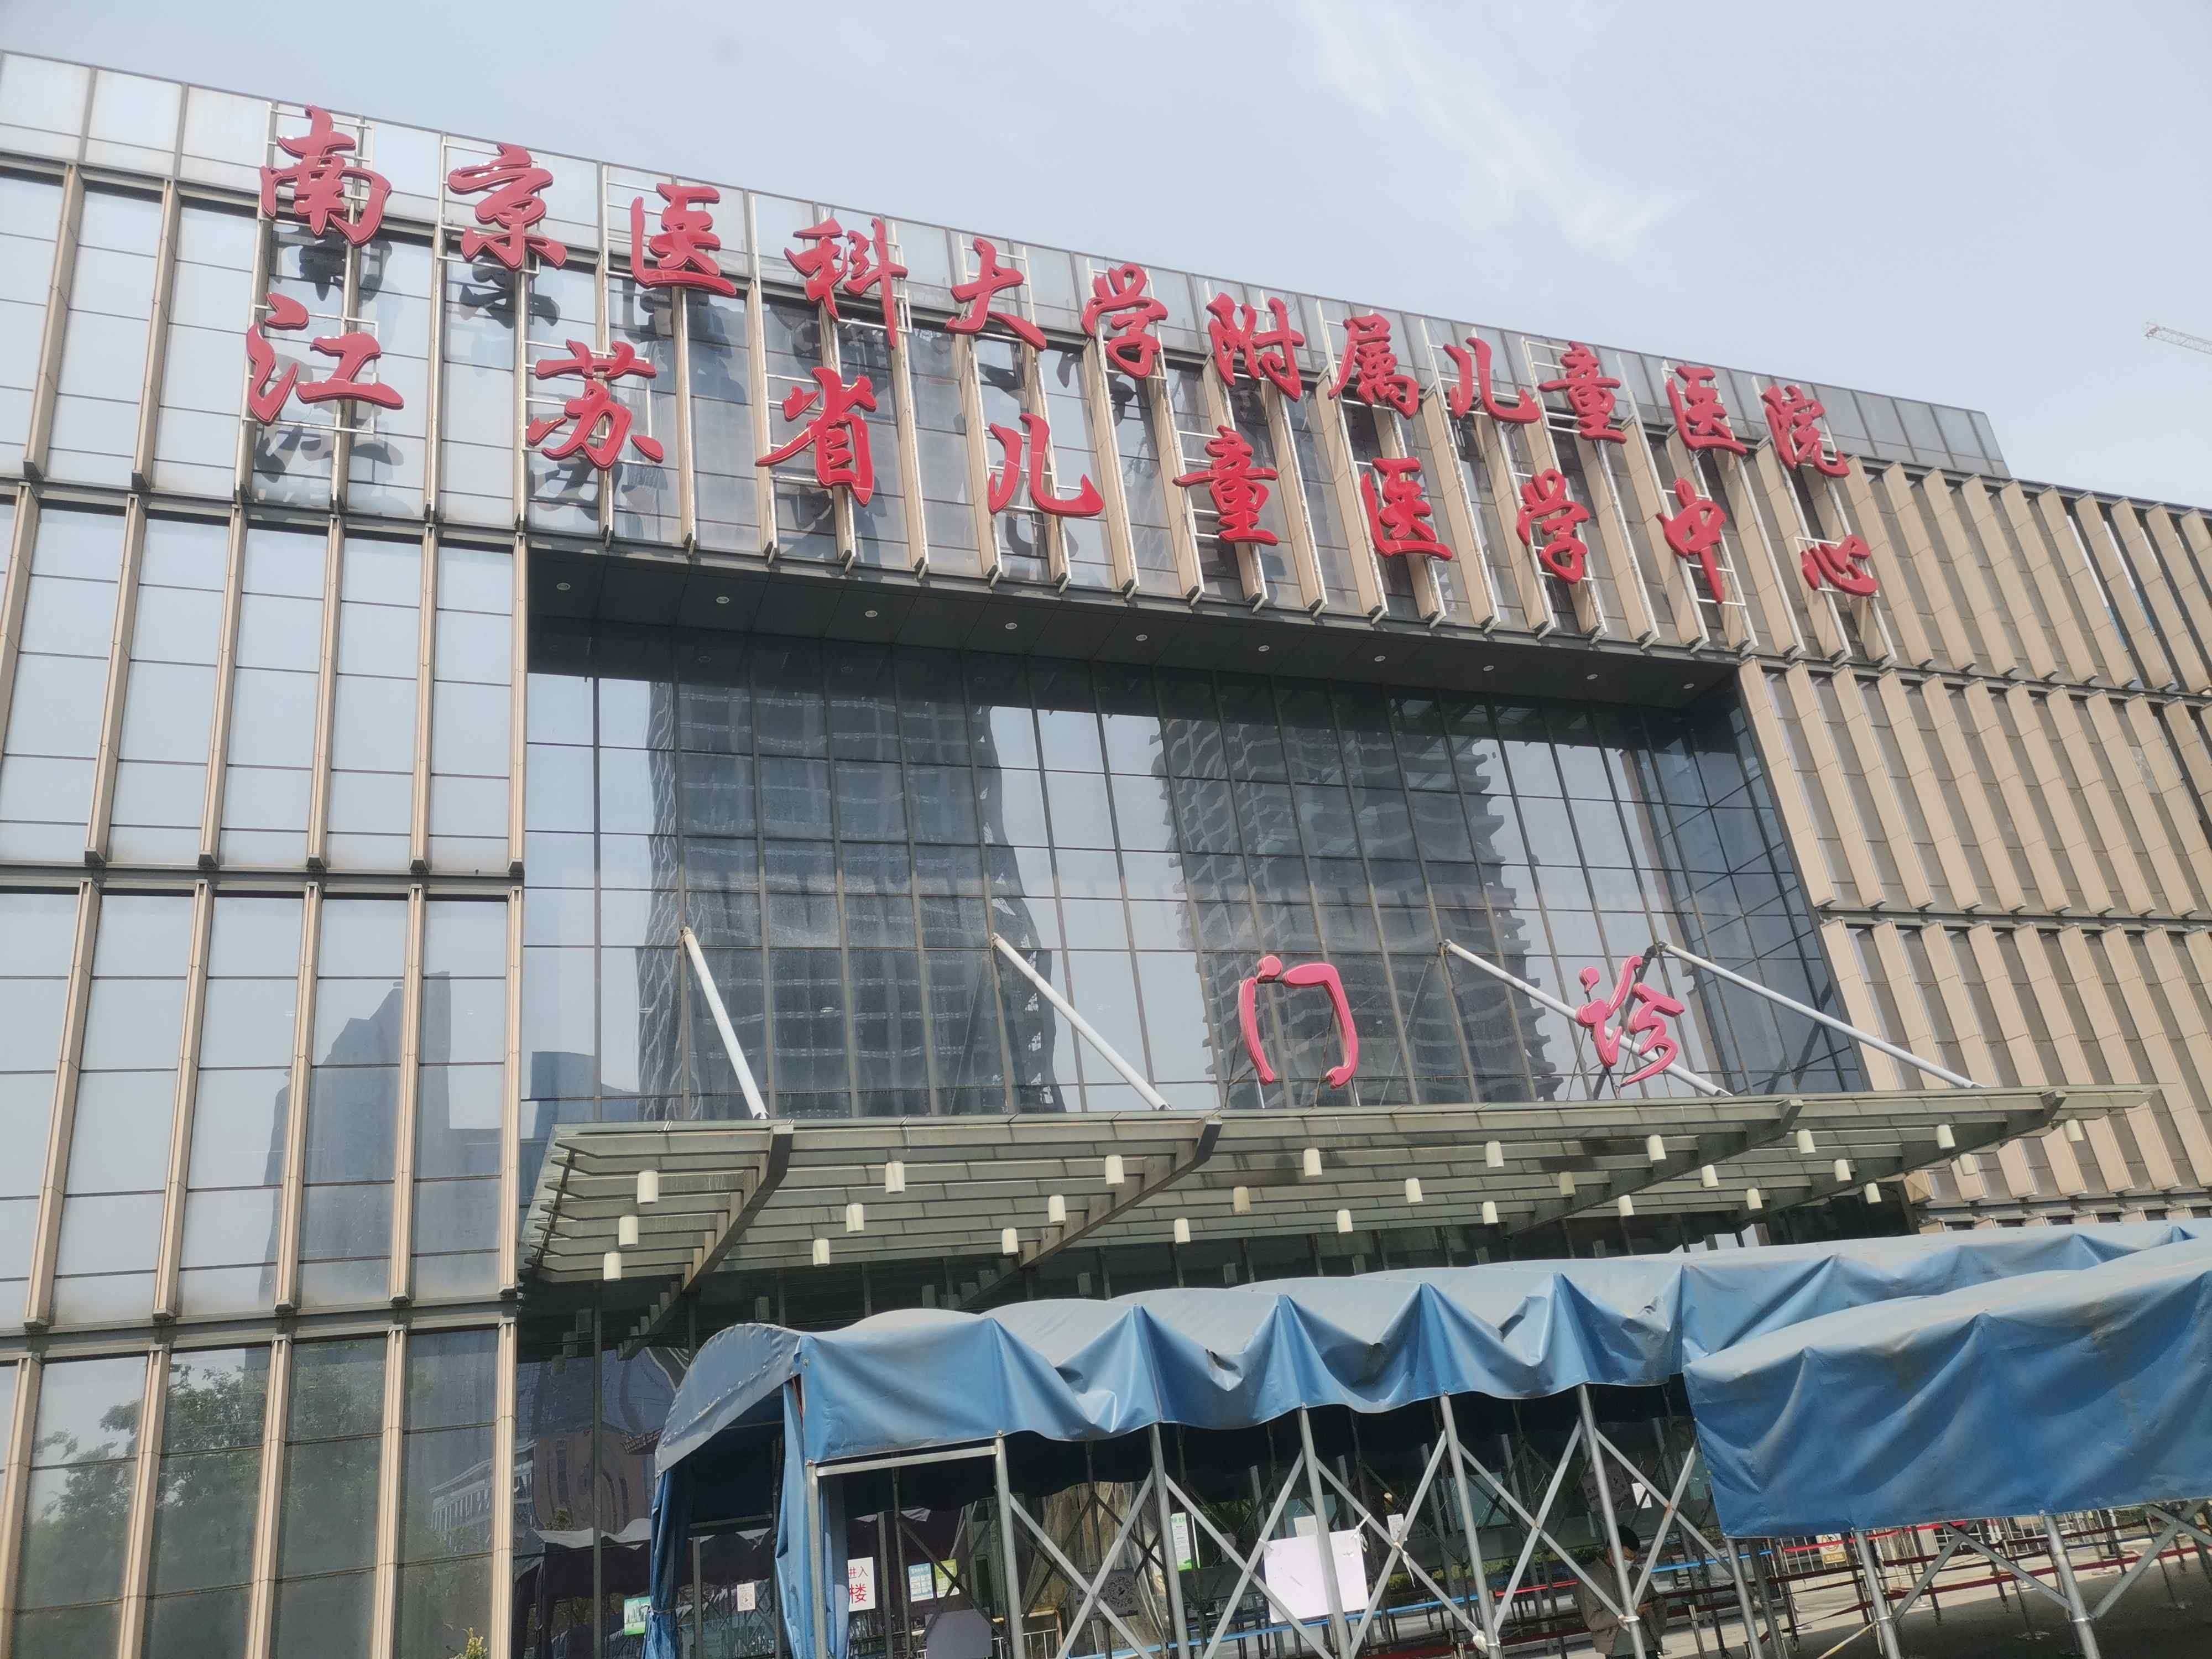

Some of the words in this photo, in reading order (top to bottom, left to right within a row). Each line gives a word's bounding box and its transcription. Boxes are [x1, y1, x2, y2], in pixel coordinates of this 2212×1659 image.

[259, 106, 1850, 478] 南京医科大学附属儿童医院
[246, 293, 1878, 604] 江苏省儿童医学中心
[1239, 955, 1684, 1089] 门诊
